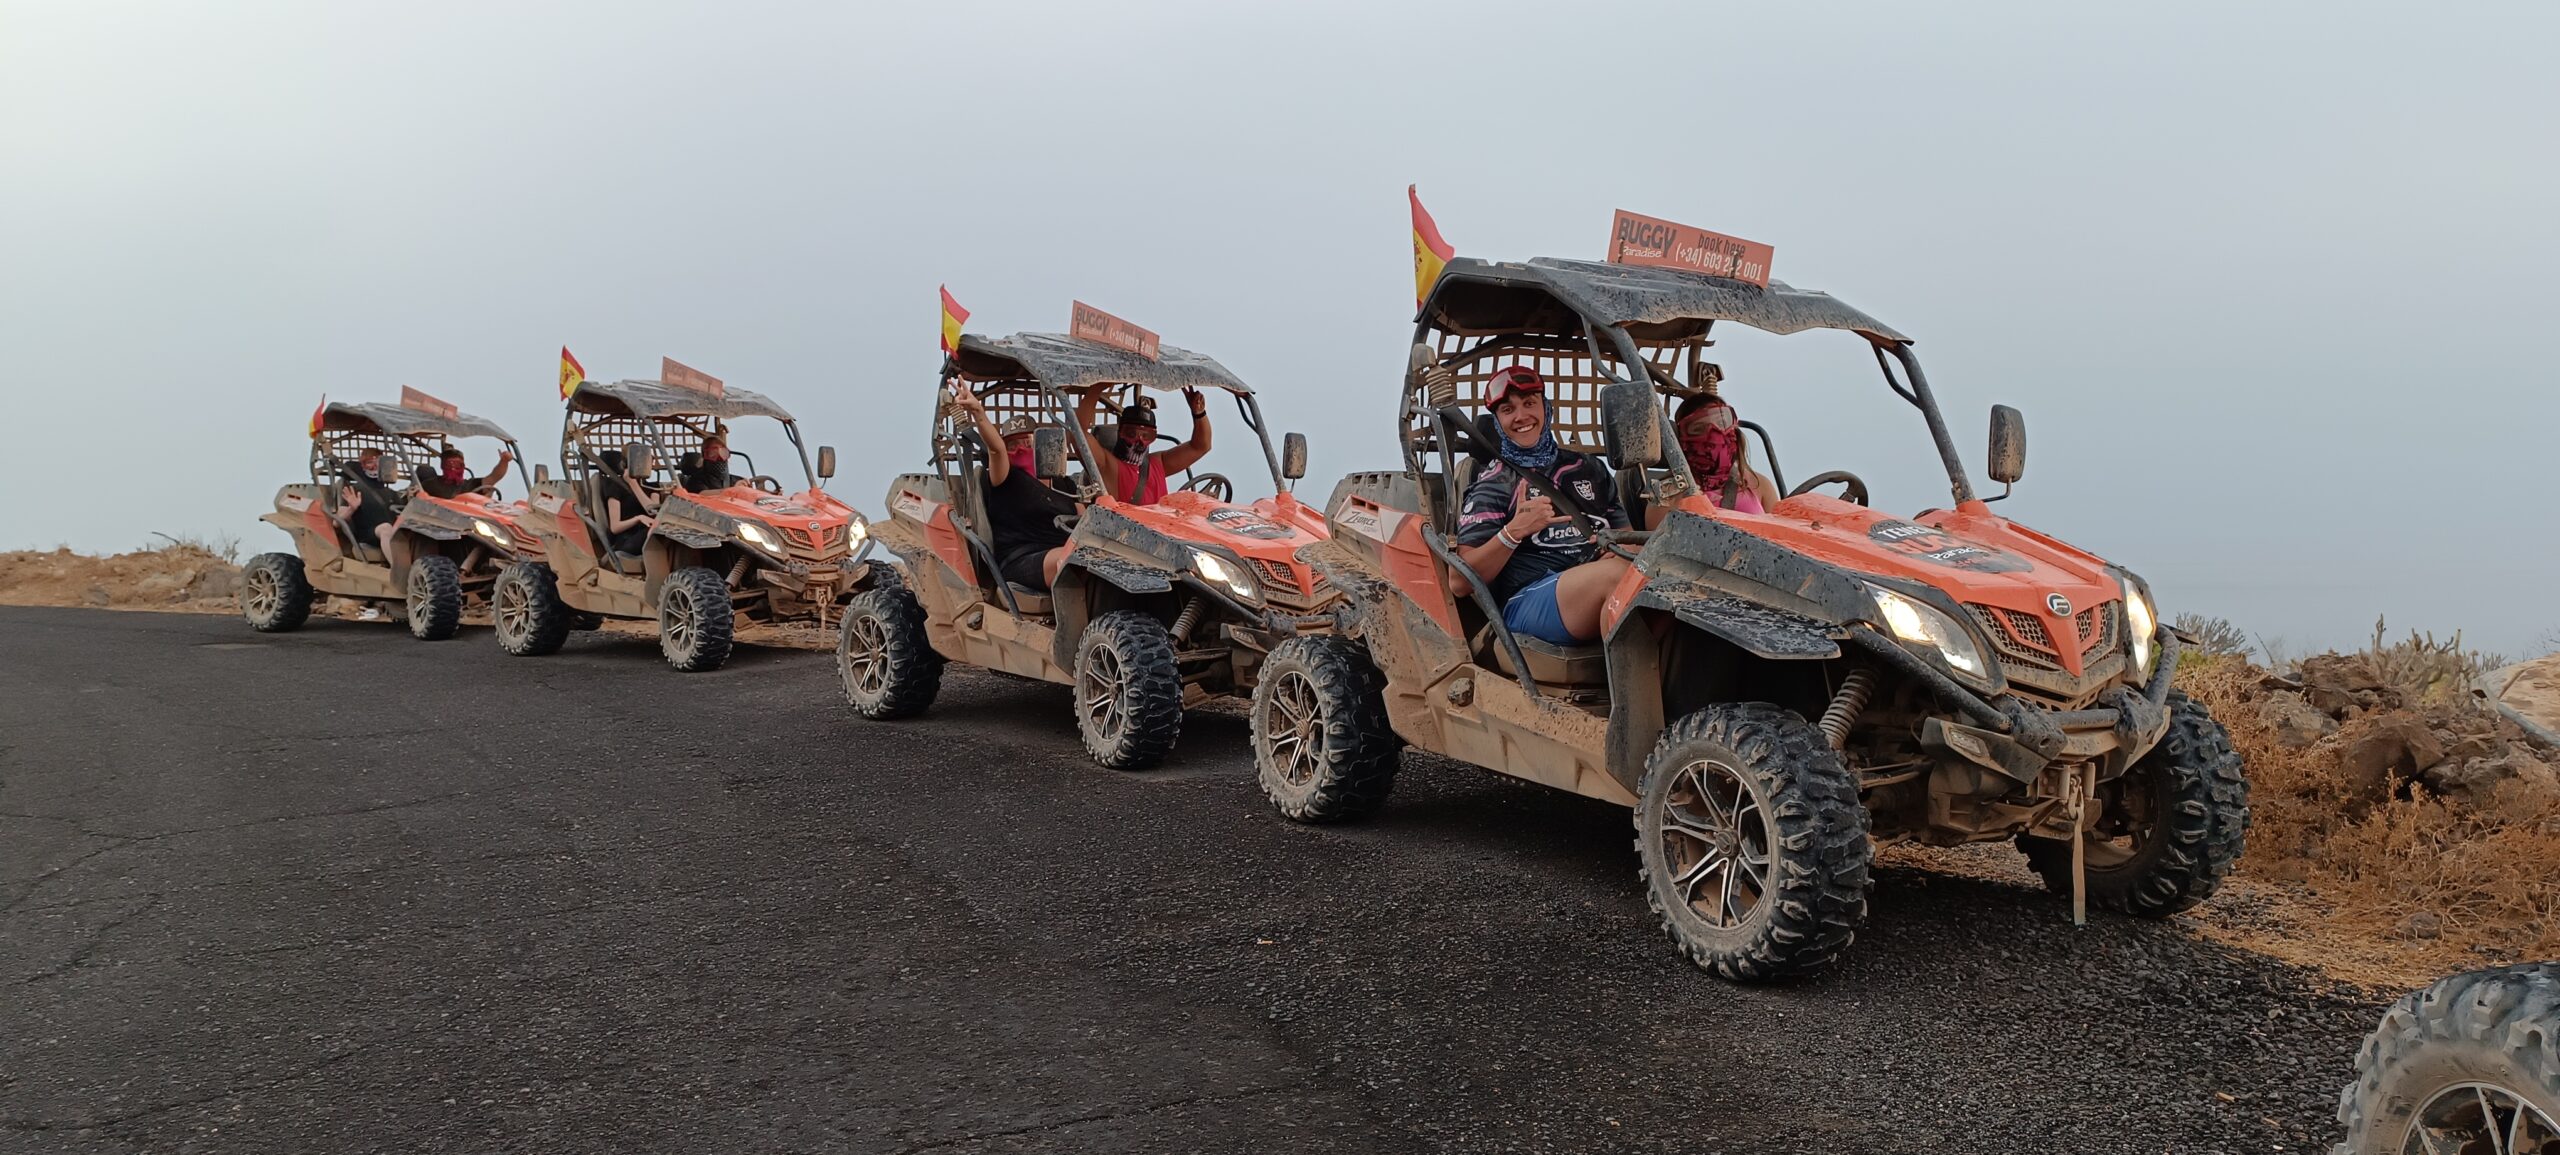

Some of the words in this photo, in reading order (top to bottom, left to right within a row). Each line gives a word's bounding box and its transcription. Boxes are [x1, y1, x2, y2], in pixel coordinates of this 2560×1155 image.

[1617, 217, 1677, 258] BUGGY
[1697, 232, 1722, 253] book
[1723, 239, 1746, 258] here
[1675, 242, 1702, 267] (+34)
[1703, 252, 1722, 270] 603
[1743, 262, 1762, 281] 001
[1075, 306, 1110, 337] BUGGY
[1010, 418, 1027, 431] M
